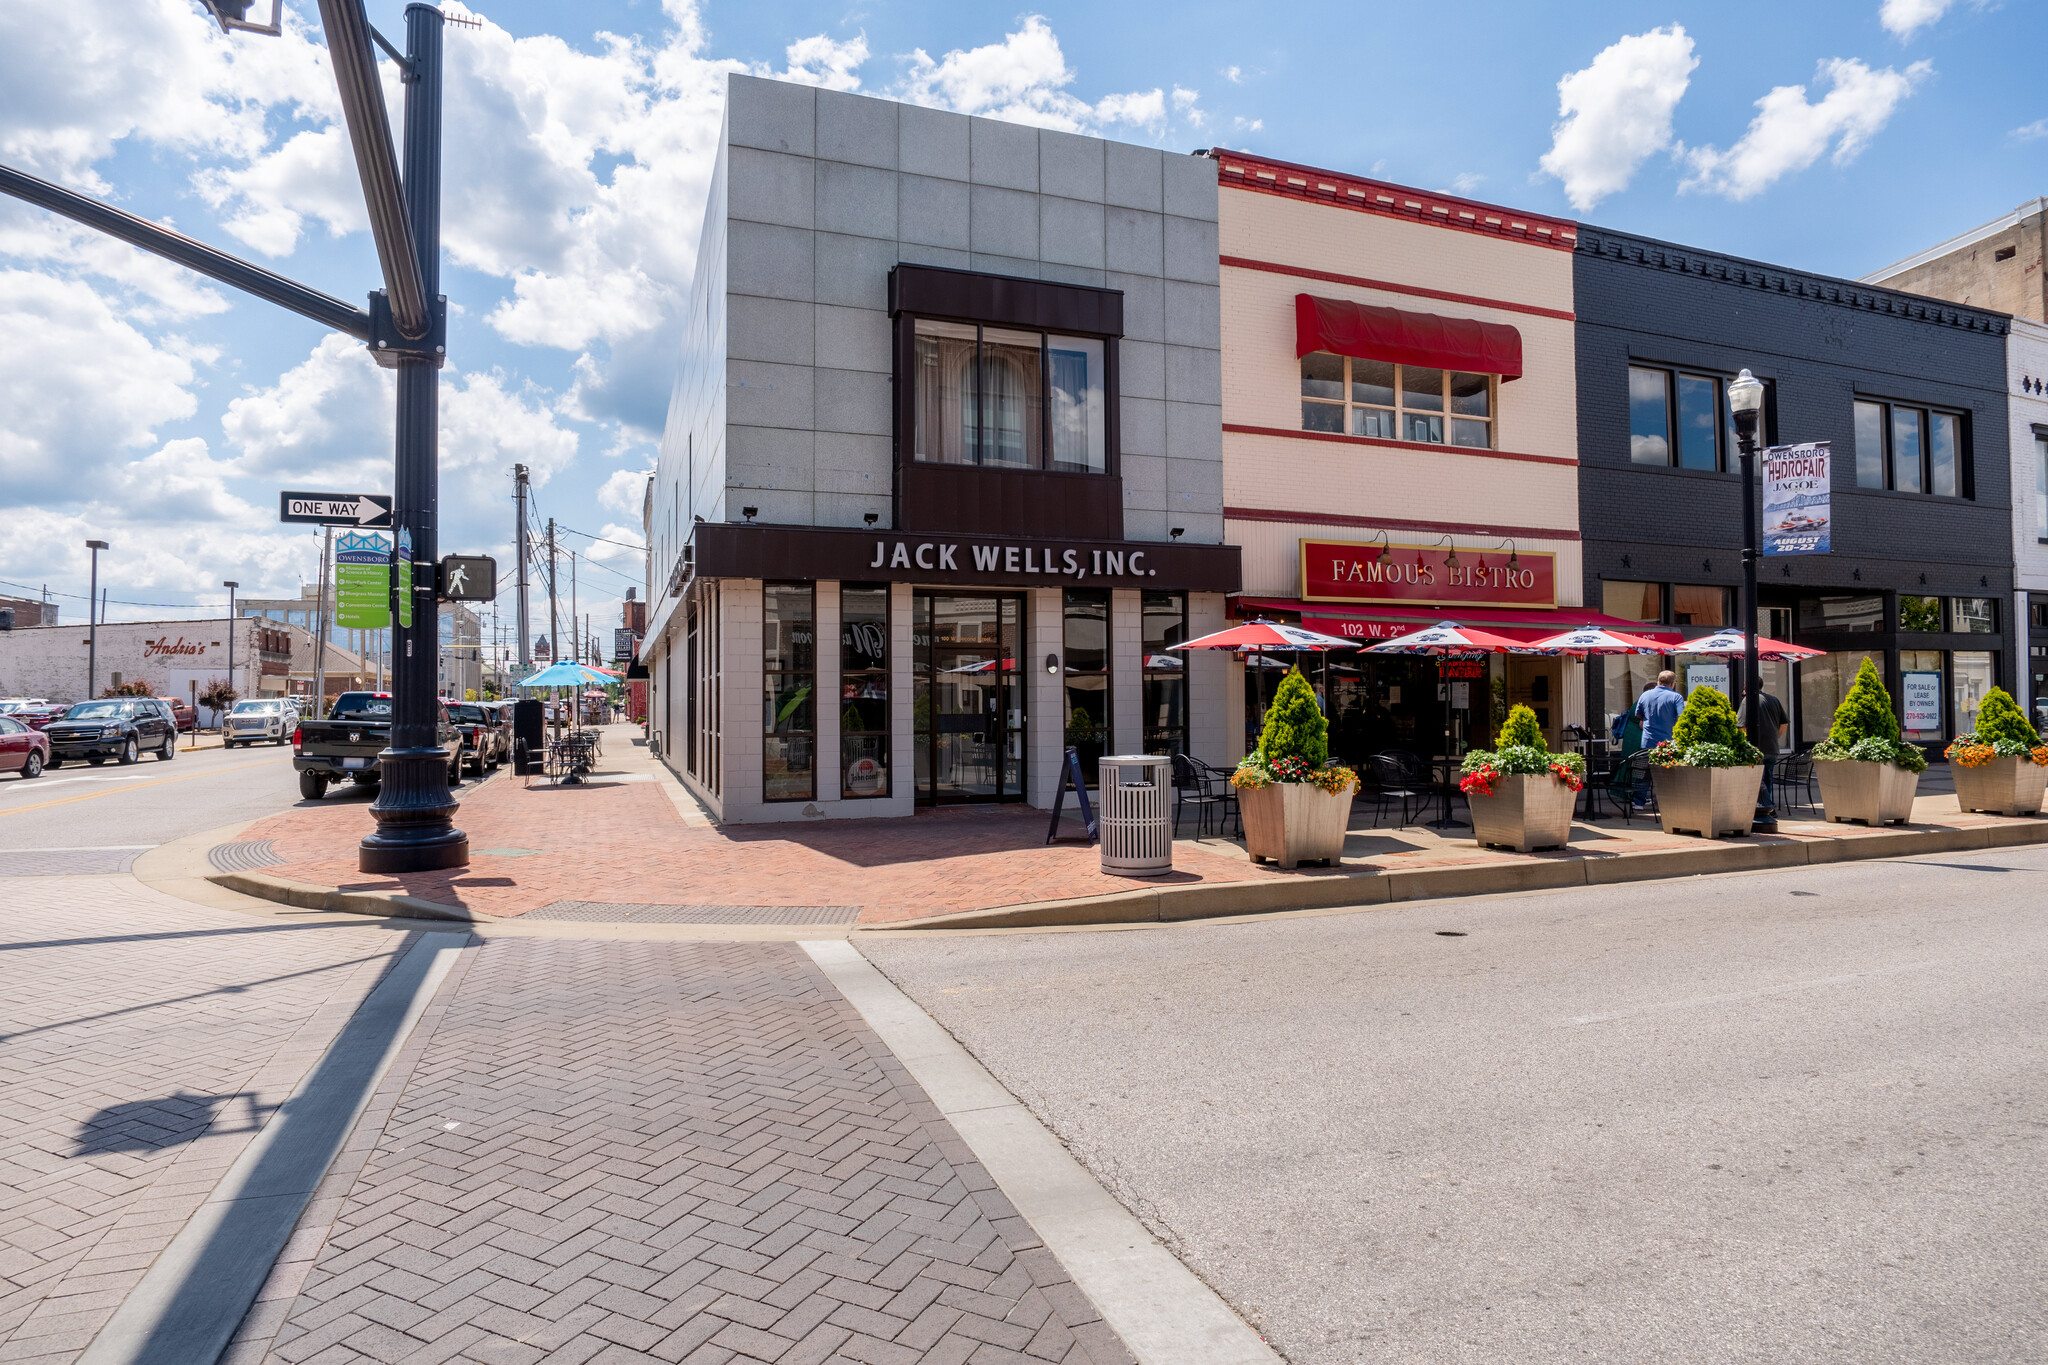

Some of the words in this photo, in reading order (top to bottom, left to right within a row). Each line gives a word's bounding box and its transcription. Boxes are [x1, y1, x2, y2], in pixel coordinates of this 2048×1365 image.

[1768, 449, 1825, 461] OWENSBORO
[1768, 458, 1825, 482] HYDROFAIR
[1773, 480, 1819, 491] JAGOE
[293, 501, 323, 514] ONE
[328, 502, 359, 516] WAY
[1773, 537, 1820, 545] AUGUST
[1777, 544, 1815, 552] 20-22
[338, 554, 389, 563] OWENSBORO
[871, 541, 958, 571] JACK
[1092, 550, 1156, 576] INC.
[1332, 559, 1435, 585] FAMOUS
[1448, 565, 1535, 589] BISTRO
[1341, 623, 1364, 637] 102
[1368, 624, 1386, 638] W.
[143, 636, 207, 658] Andria's
[1691, 675, 1704, 683] FOR
[1704, 675, 1720, 683] SALE
